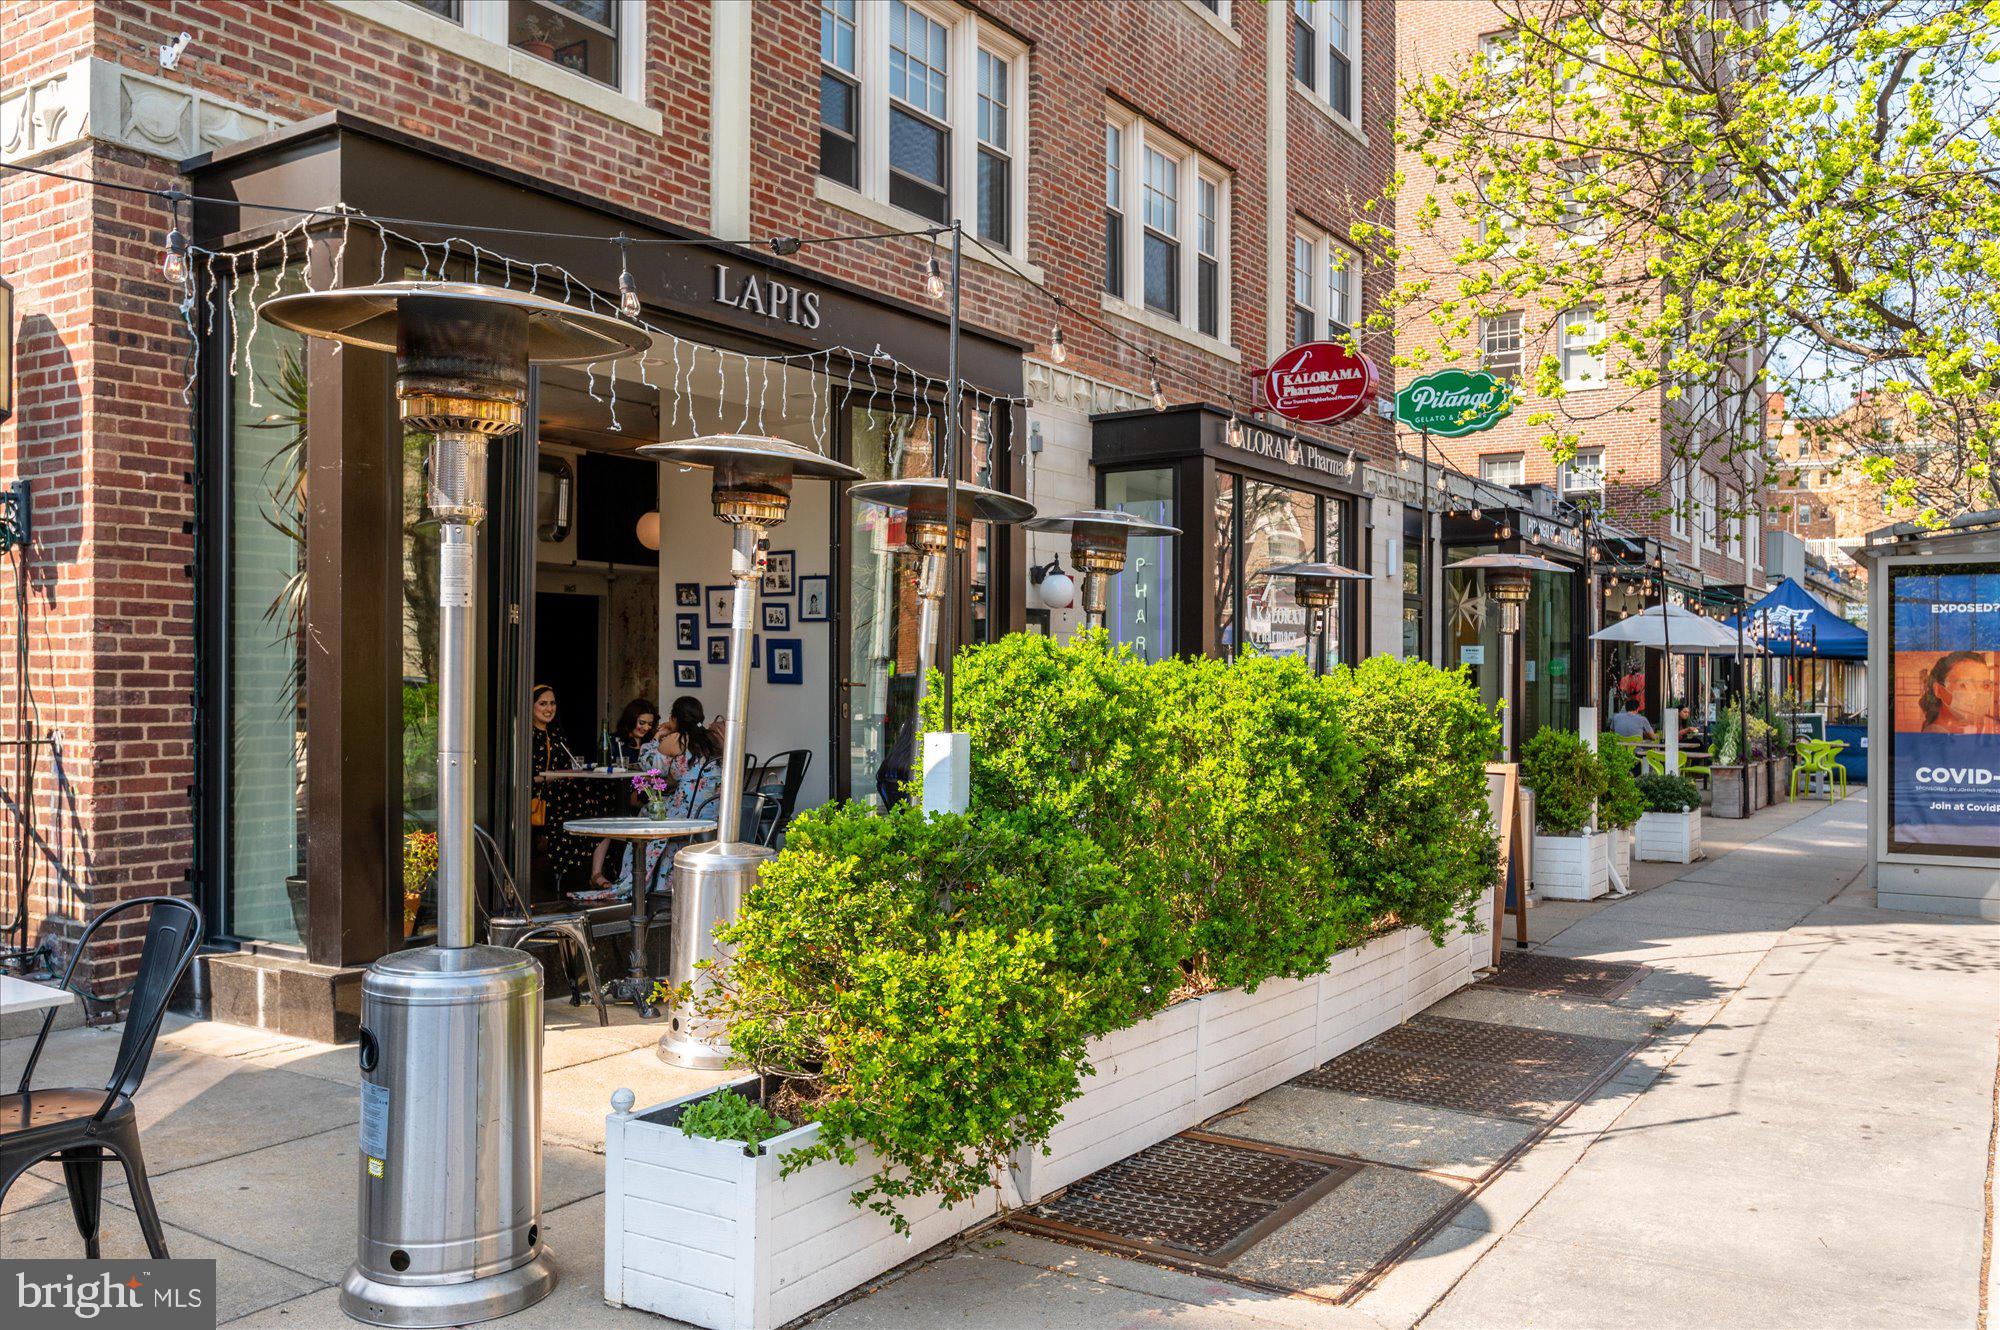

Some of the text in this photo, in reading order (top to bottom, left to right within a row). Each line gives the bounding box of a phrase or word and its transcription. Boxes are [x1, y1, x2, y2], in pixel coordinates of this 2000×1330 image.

[713, 263, 820, 329] LAPIS
[1282, 368, 1362, 386] KALORAMA
[1282, 384, 1339, 397] Pharmacy
[1411, 386, 1494, 412] Pitango
[1415, 415, 1446, 423] GELATO
[1306, 446, 1356, 484] Pharma
[1527, 518, 1550, 539] PITNGO
[1931, 603, 2000, 613] EXPOSED?
[1915, 767, 2000, 785] COVID-
[1930, 802, 1951, 810] Join
[1953, 803, 1964, 811] at
